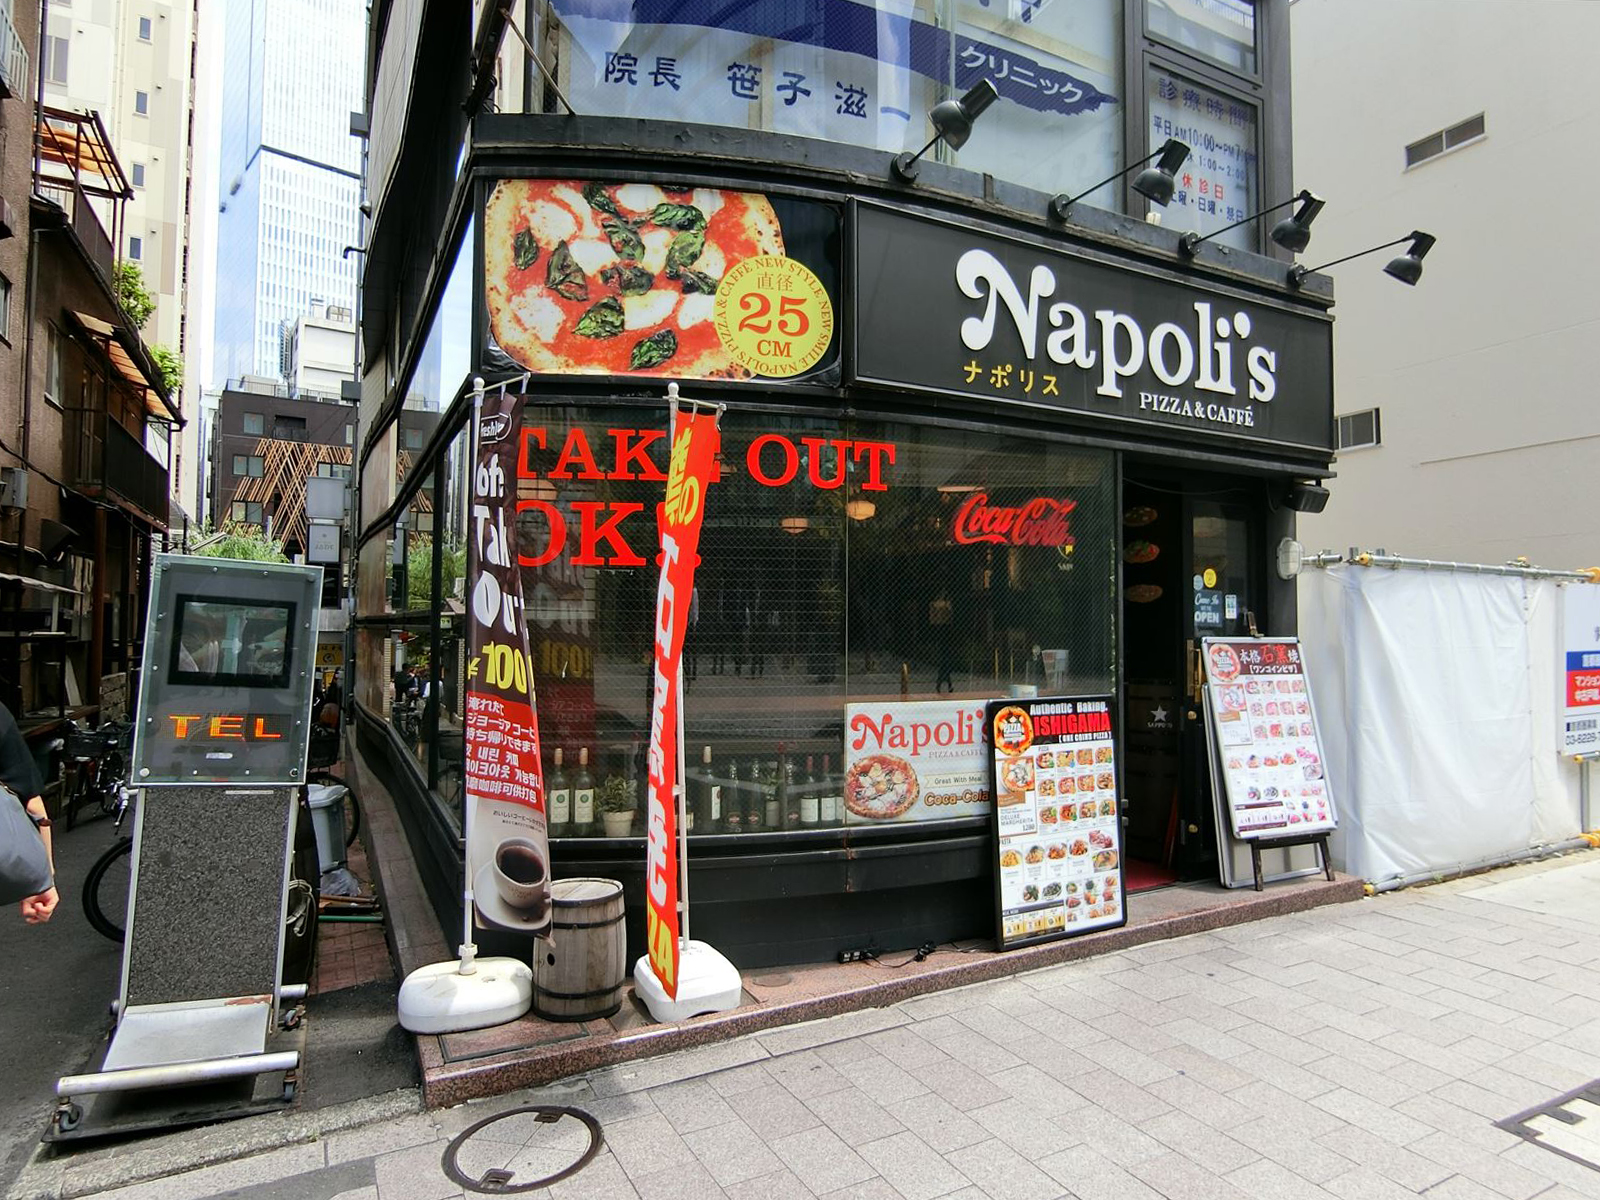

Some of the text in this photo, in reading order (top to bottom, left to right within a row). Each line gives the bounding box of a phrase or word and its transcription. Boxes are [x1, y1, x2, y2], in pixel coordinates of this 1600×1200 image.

[604, 52, 911, 121] 院長 笹子滋一
[960, 45, 1083, 103] クリニック
[1182, 172, 1224, 200] 休診日
[754, 257, 788, 269] NEW
[756, 271, 795, 292] 直径
[738, 292, 810, 338] 25
[955, 248, 1277, 402] Napoli's
[756, 339, 793, 359] CM
[963, 360, 1060, 396] ナポリス
[746, 433, 896, 492] OUT
[1193, 610, 1220, 624] OPEN
[1029, 702, 1073, 716] Authentic
[168, 713, 282, 739] TEL
[1033, 712, 1112, 737] ISHIGAMA
[934, 776, 952, 785] Great
[953, 774, 968, 784] With
[923, 788, 990, 807] Coca-Cola
